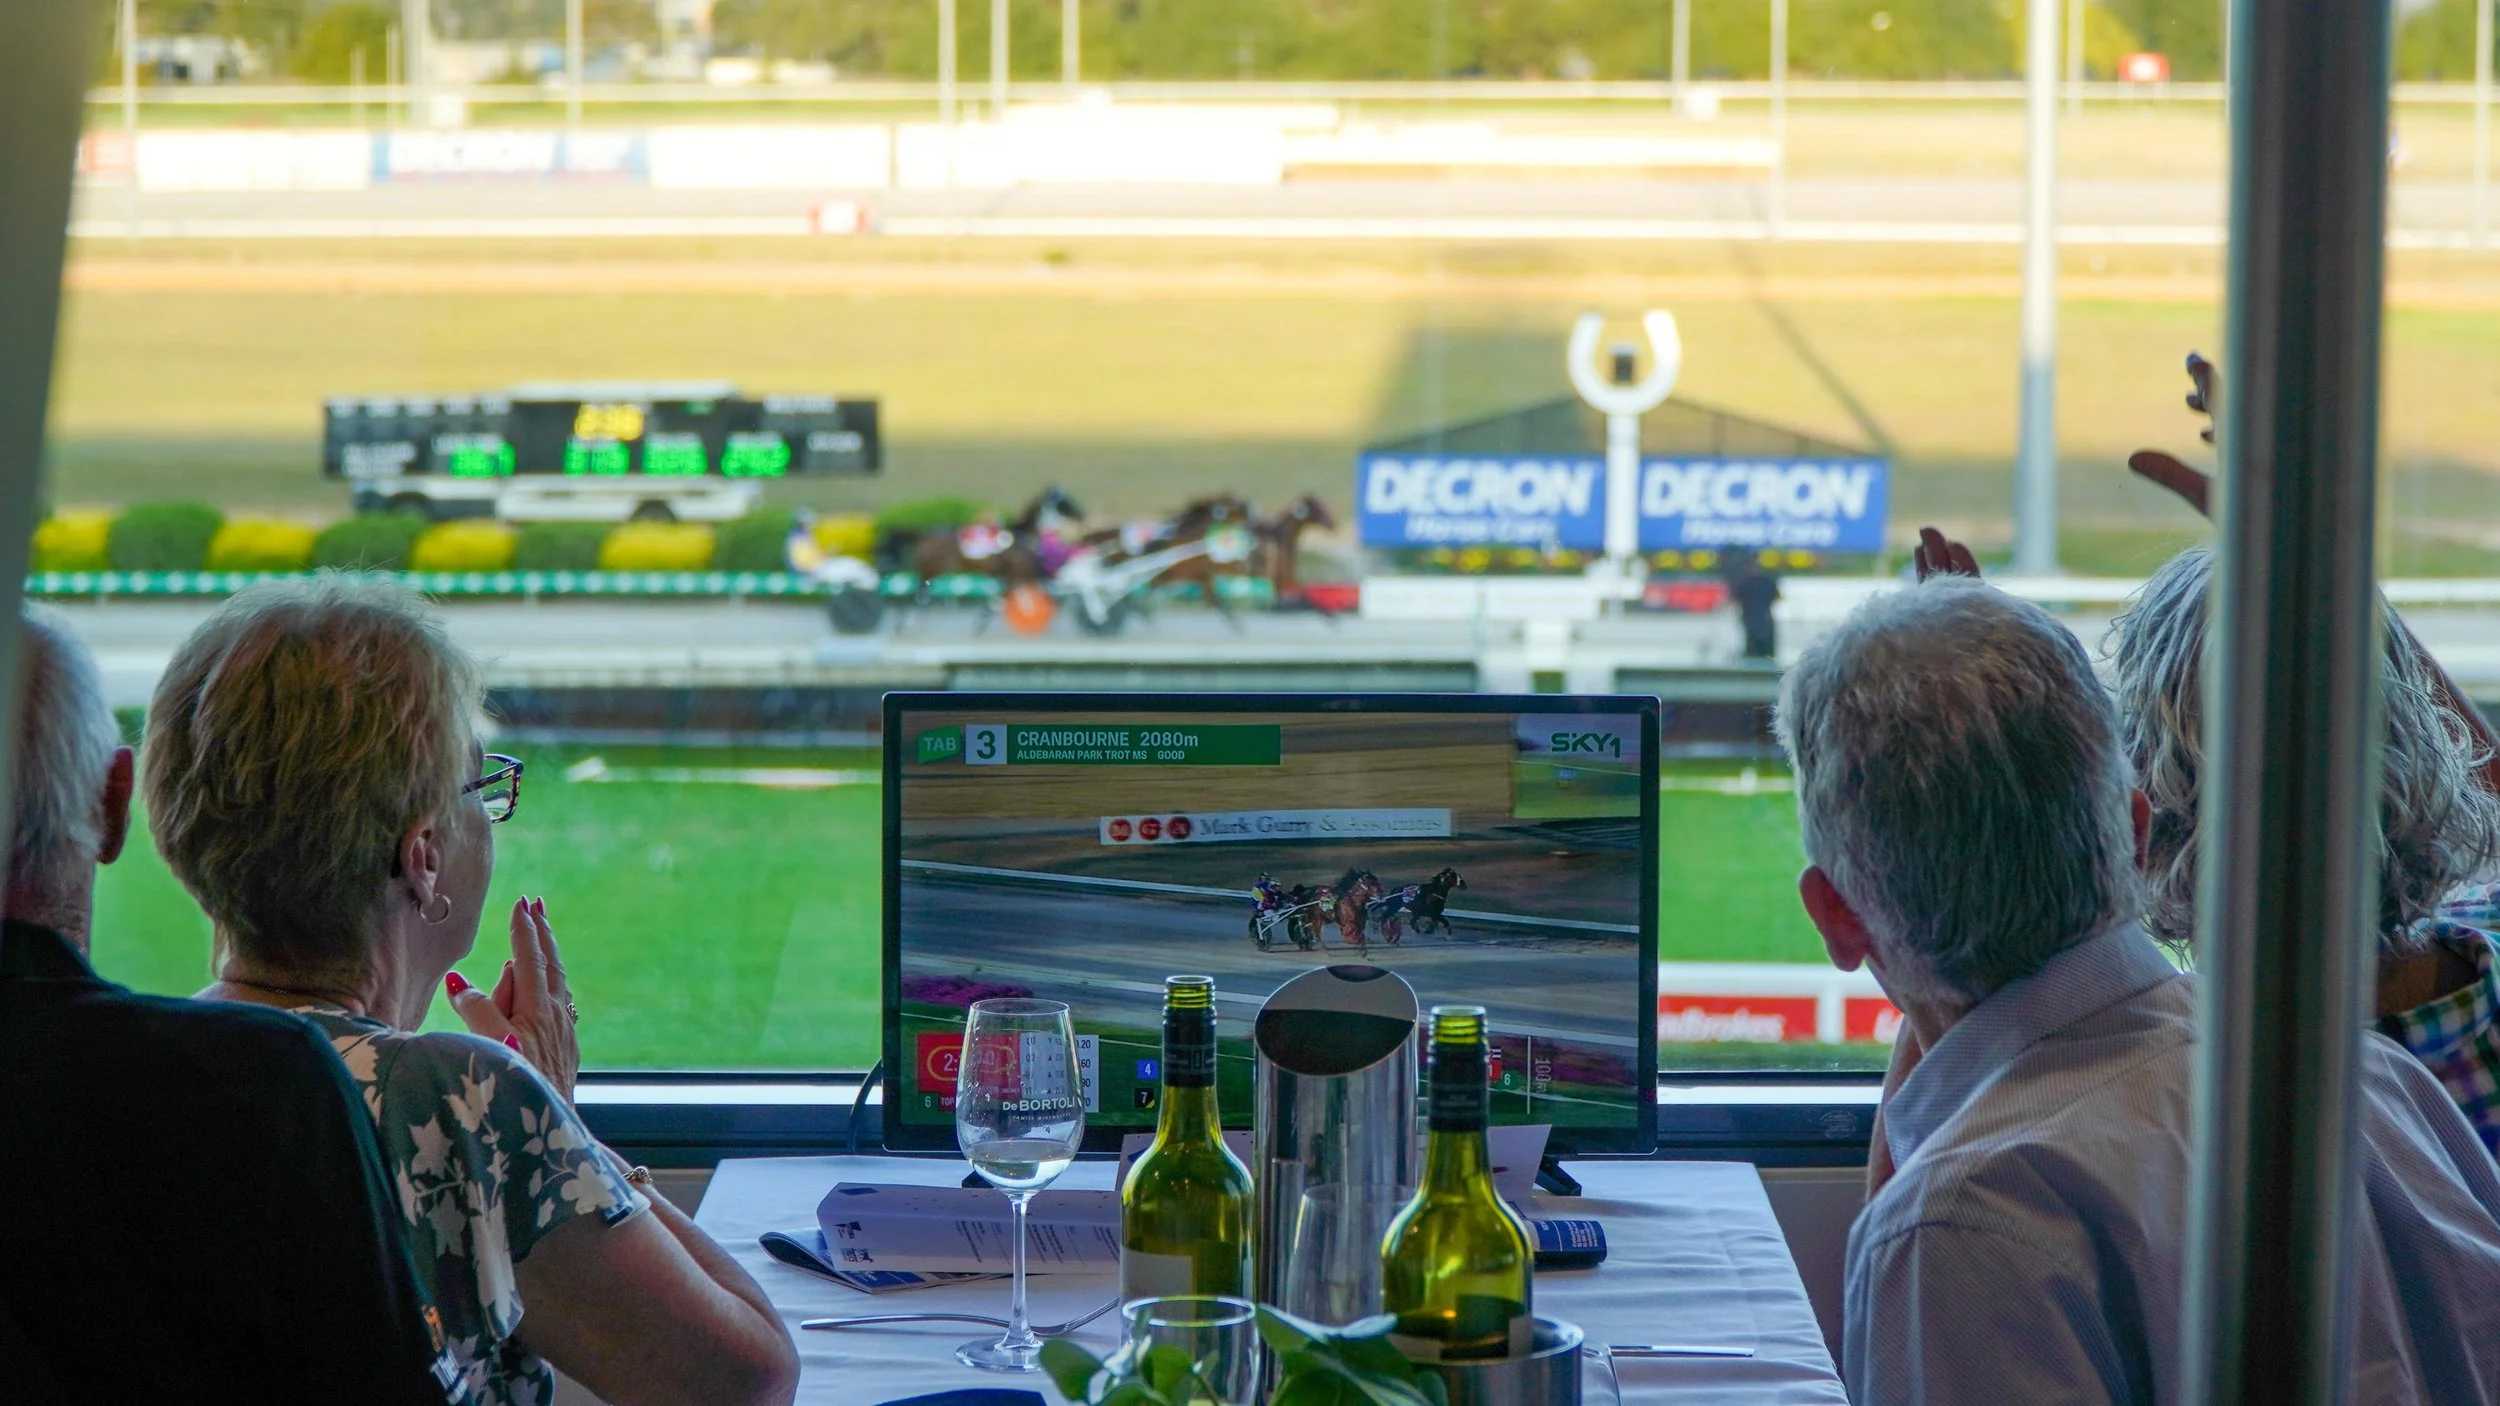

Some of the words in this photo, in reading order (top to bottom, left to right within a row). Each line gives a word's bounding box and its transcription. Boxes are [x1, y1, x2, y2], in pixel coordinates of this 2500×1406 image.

[1366, 459, 1592, 516] DECRON
[1640, 462, 1870, 520] DECRON
[924, 737, 956, 751] TAB
[976, 730, 996, 759] 3
[1017, 731, 1129, 746] CRANBOURNE
[1140, 731, 1199, 746] 2080m
[1017, 750, 1075, 760] ALDEBARAN
[1077, 750, 1103, 760] PARK
[1105, 750, 1130, 760] TROT
[1132, 750, 1148, 760] MS
[1157, 750, 1185, 760] GOOD
[1144, 1063, 1152, 1076] 4
[1503, 1073, 1511, 1086] 6
[924, 1095, 932, 1108] 6
[1002, 1101, 1018, 1111] De
[1019, 1096, 1075, 1112] BORTOLI
[1140, 1091, 1148, 1104] 7
